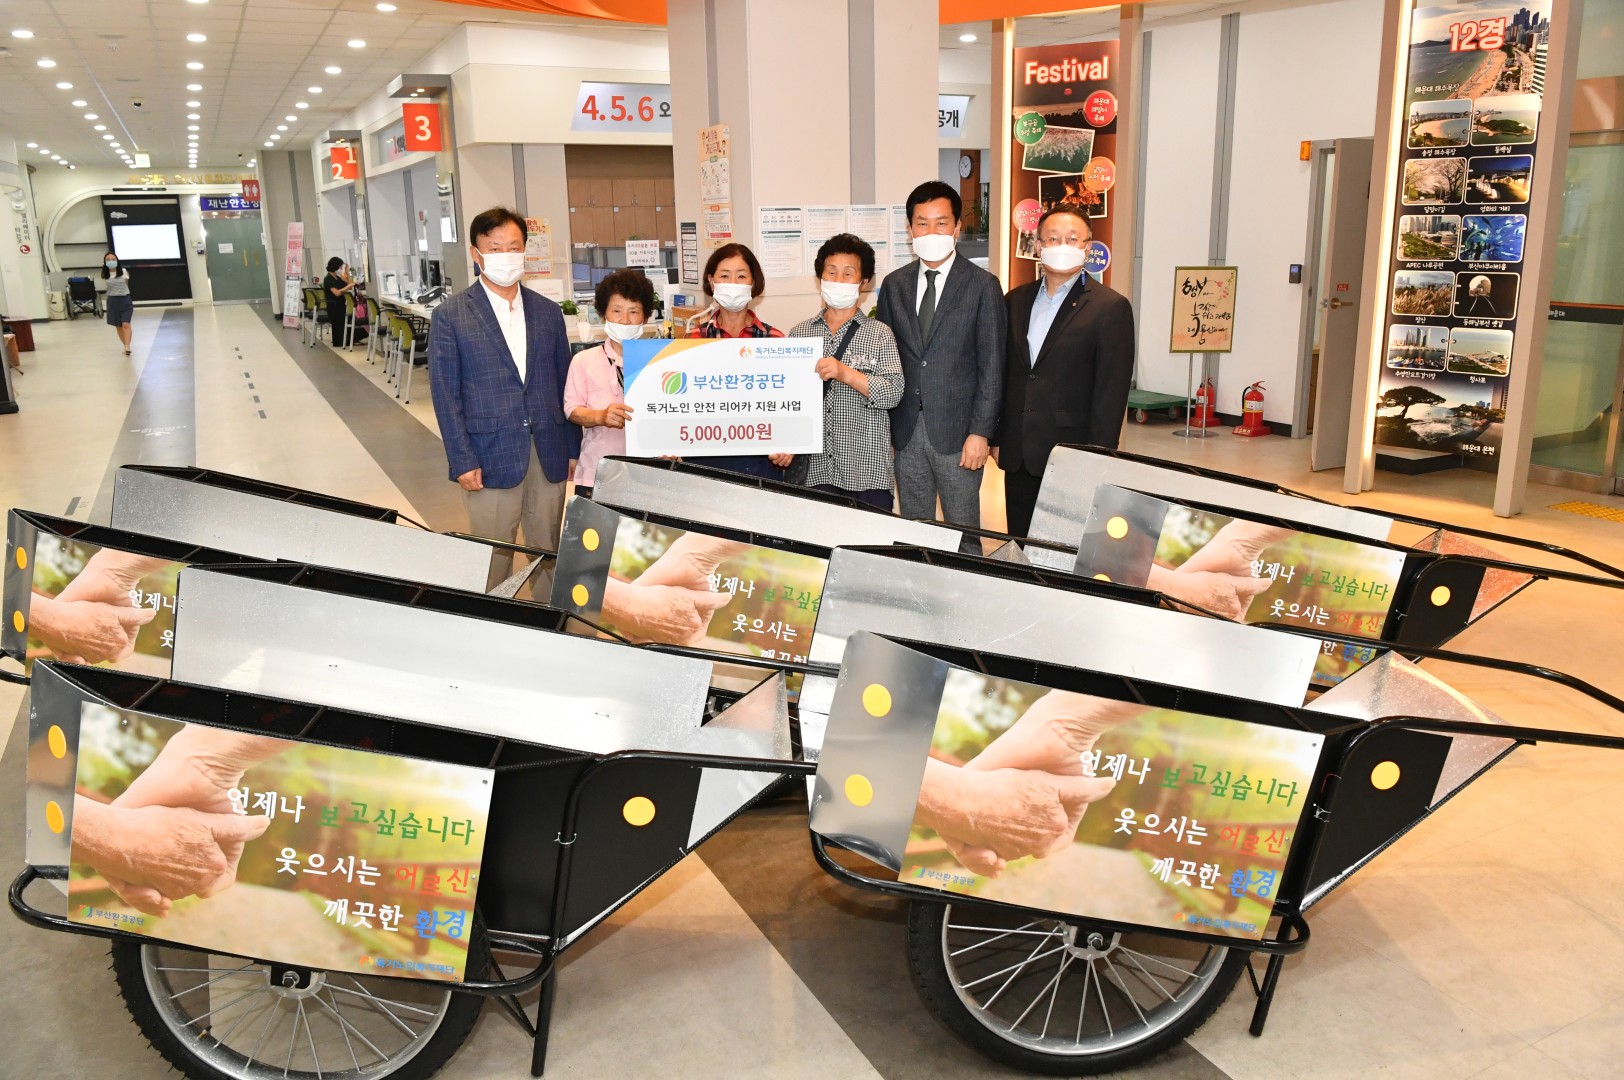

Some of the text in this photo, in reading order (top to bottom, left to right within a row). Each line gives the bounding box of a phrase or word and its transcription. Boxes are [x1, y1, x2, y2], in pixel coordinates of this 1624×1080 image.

[1450, 17, 1507, 52] 12경
[1024, 55, 1109, 85] Festival
[1414, 82, 1460, 95] 해운대 해수욕장
[581, 94, 654, 123] 4.5.6
[415, 115, 432, 141] 3
[345, 147, 357, 164] 1
[1434, 148, 1457, 156] 해수욕장
[1494, 146, 1512, 154] 동백섬
[332, 163, 345, 180] 2
[1423, 206, 1446, 214] 달맞이길
[755, 346, 814, 355] 독거노인복지재단
[693, 373, 786, 390] 부산환경공단
[646, 400, 801, 414] 독거노인 안전 리어카 지원 사업
[679, 422, 773, 444] 5,000,000원
[1462, 444, 1481, 453] 해운대
[1250, 559, 1295, 584] 언제나
[706, 573, 756, 599] 언제나
[1270, 598, 1381, 635] 웃으시는 어르신
[732, 613, 798, 643] 웃으시는
[1079, 749, 1299, 808] 언제나 보고싶습니다
[227, 786, 475, 846] 언제나 보고싶습니다
[1114, 807, 1286, 857] 웃으시는 어르신
[275, 847, 470, 897] 웃으시는 어르신
[927, 870, 976, 887] 부산환경공단
[1149, 857, 1277, 898] 깨끗한 환경
[95, 909, 145, 926] 부산환경공단
[323, 898, 466, 939] 깨끗한 환경
[1186, 913, 1257, 932] 독거노인복지재단
[375, 957, 455, 975] 독거노인복지재단
